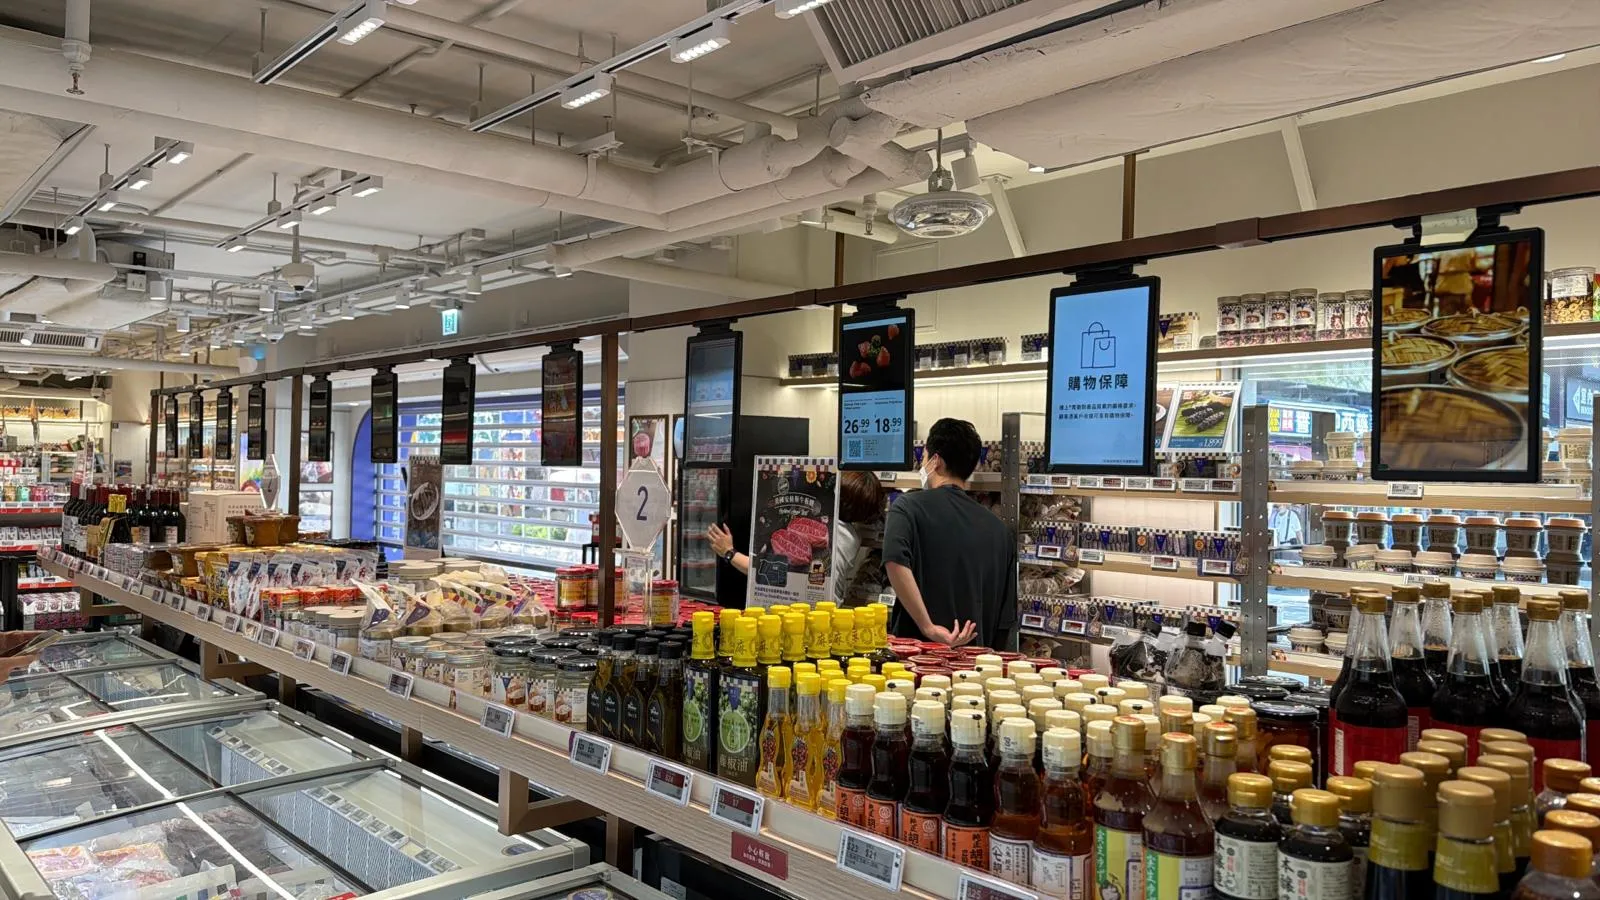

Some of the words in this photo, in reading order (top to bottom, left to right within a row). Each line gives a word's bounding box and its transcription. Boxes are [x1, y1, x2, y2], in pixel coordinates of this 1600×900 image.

[1068, 373, 1129, 391] 購物保障
[636, 485, 649, 521] 2
